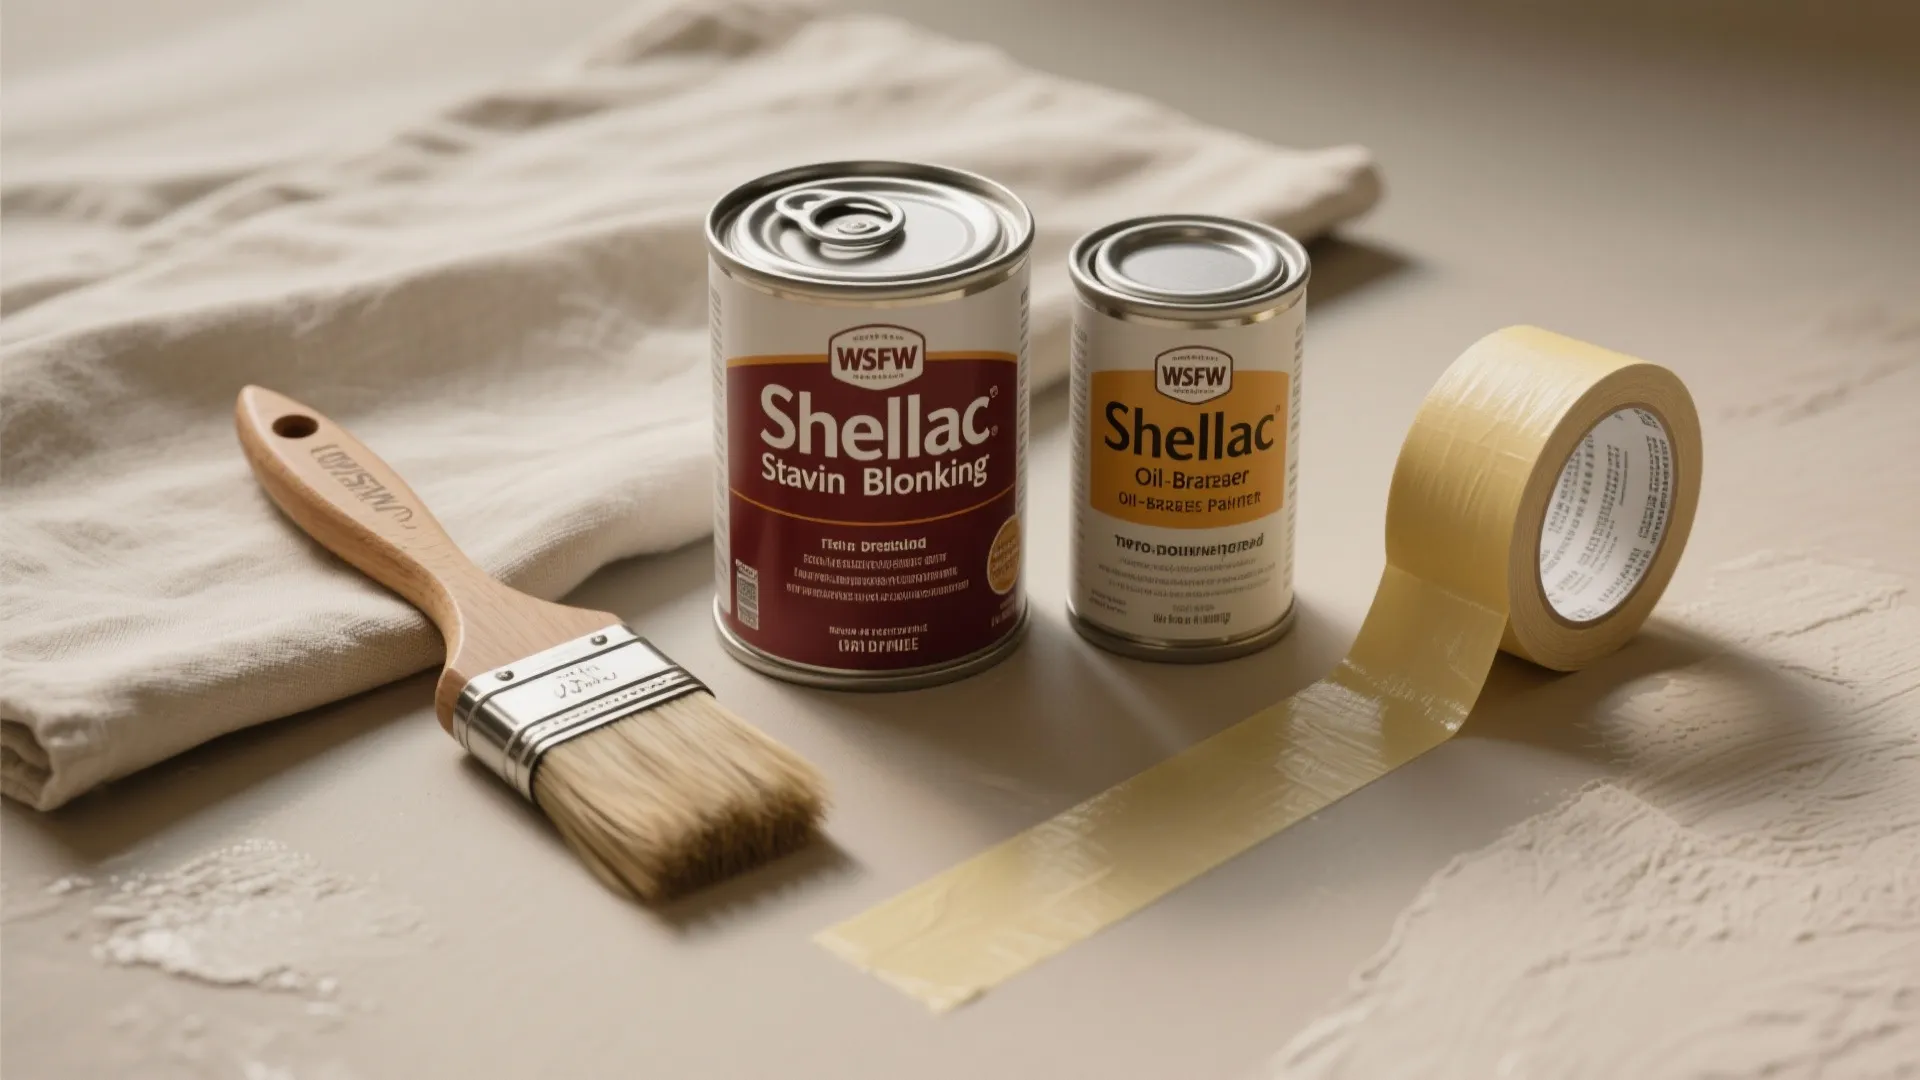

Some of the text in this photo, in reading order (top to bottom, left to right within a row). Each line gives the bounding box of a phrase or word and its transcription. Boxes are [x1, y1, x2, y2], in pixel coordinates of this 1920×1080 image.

[836, 345, 918, 372] WSFW
[1161, 365, 1227, 387] WSFW
[760, 383, 990, 462] Shellac
[1104, 401, 1275, 461] Shellac
[761, 452, 990, 497] Stavin Blonking
